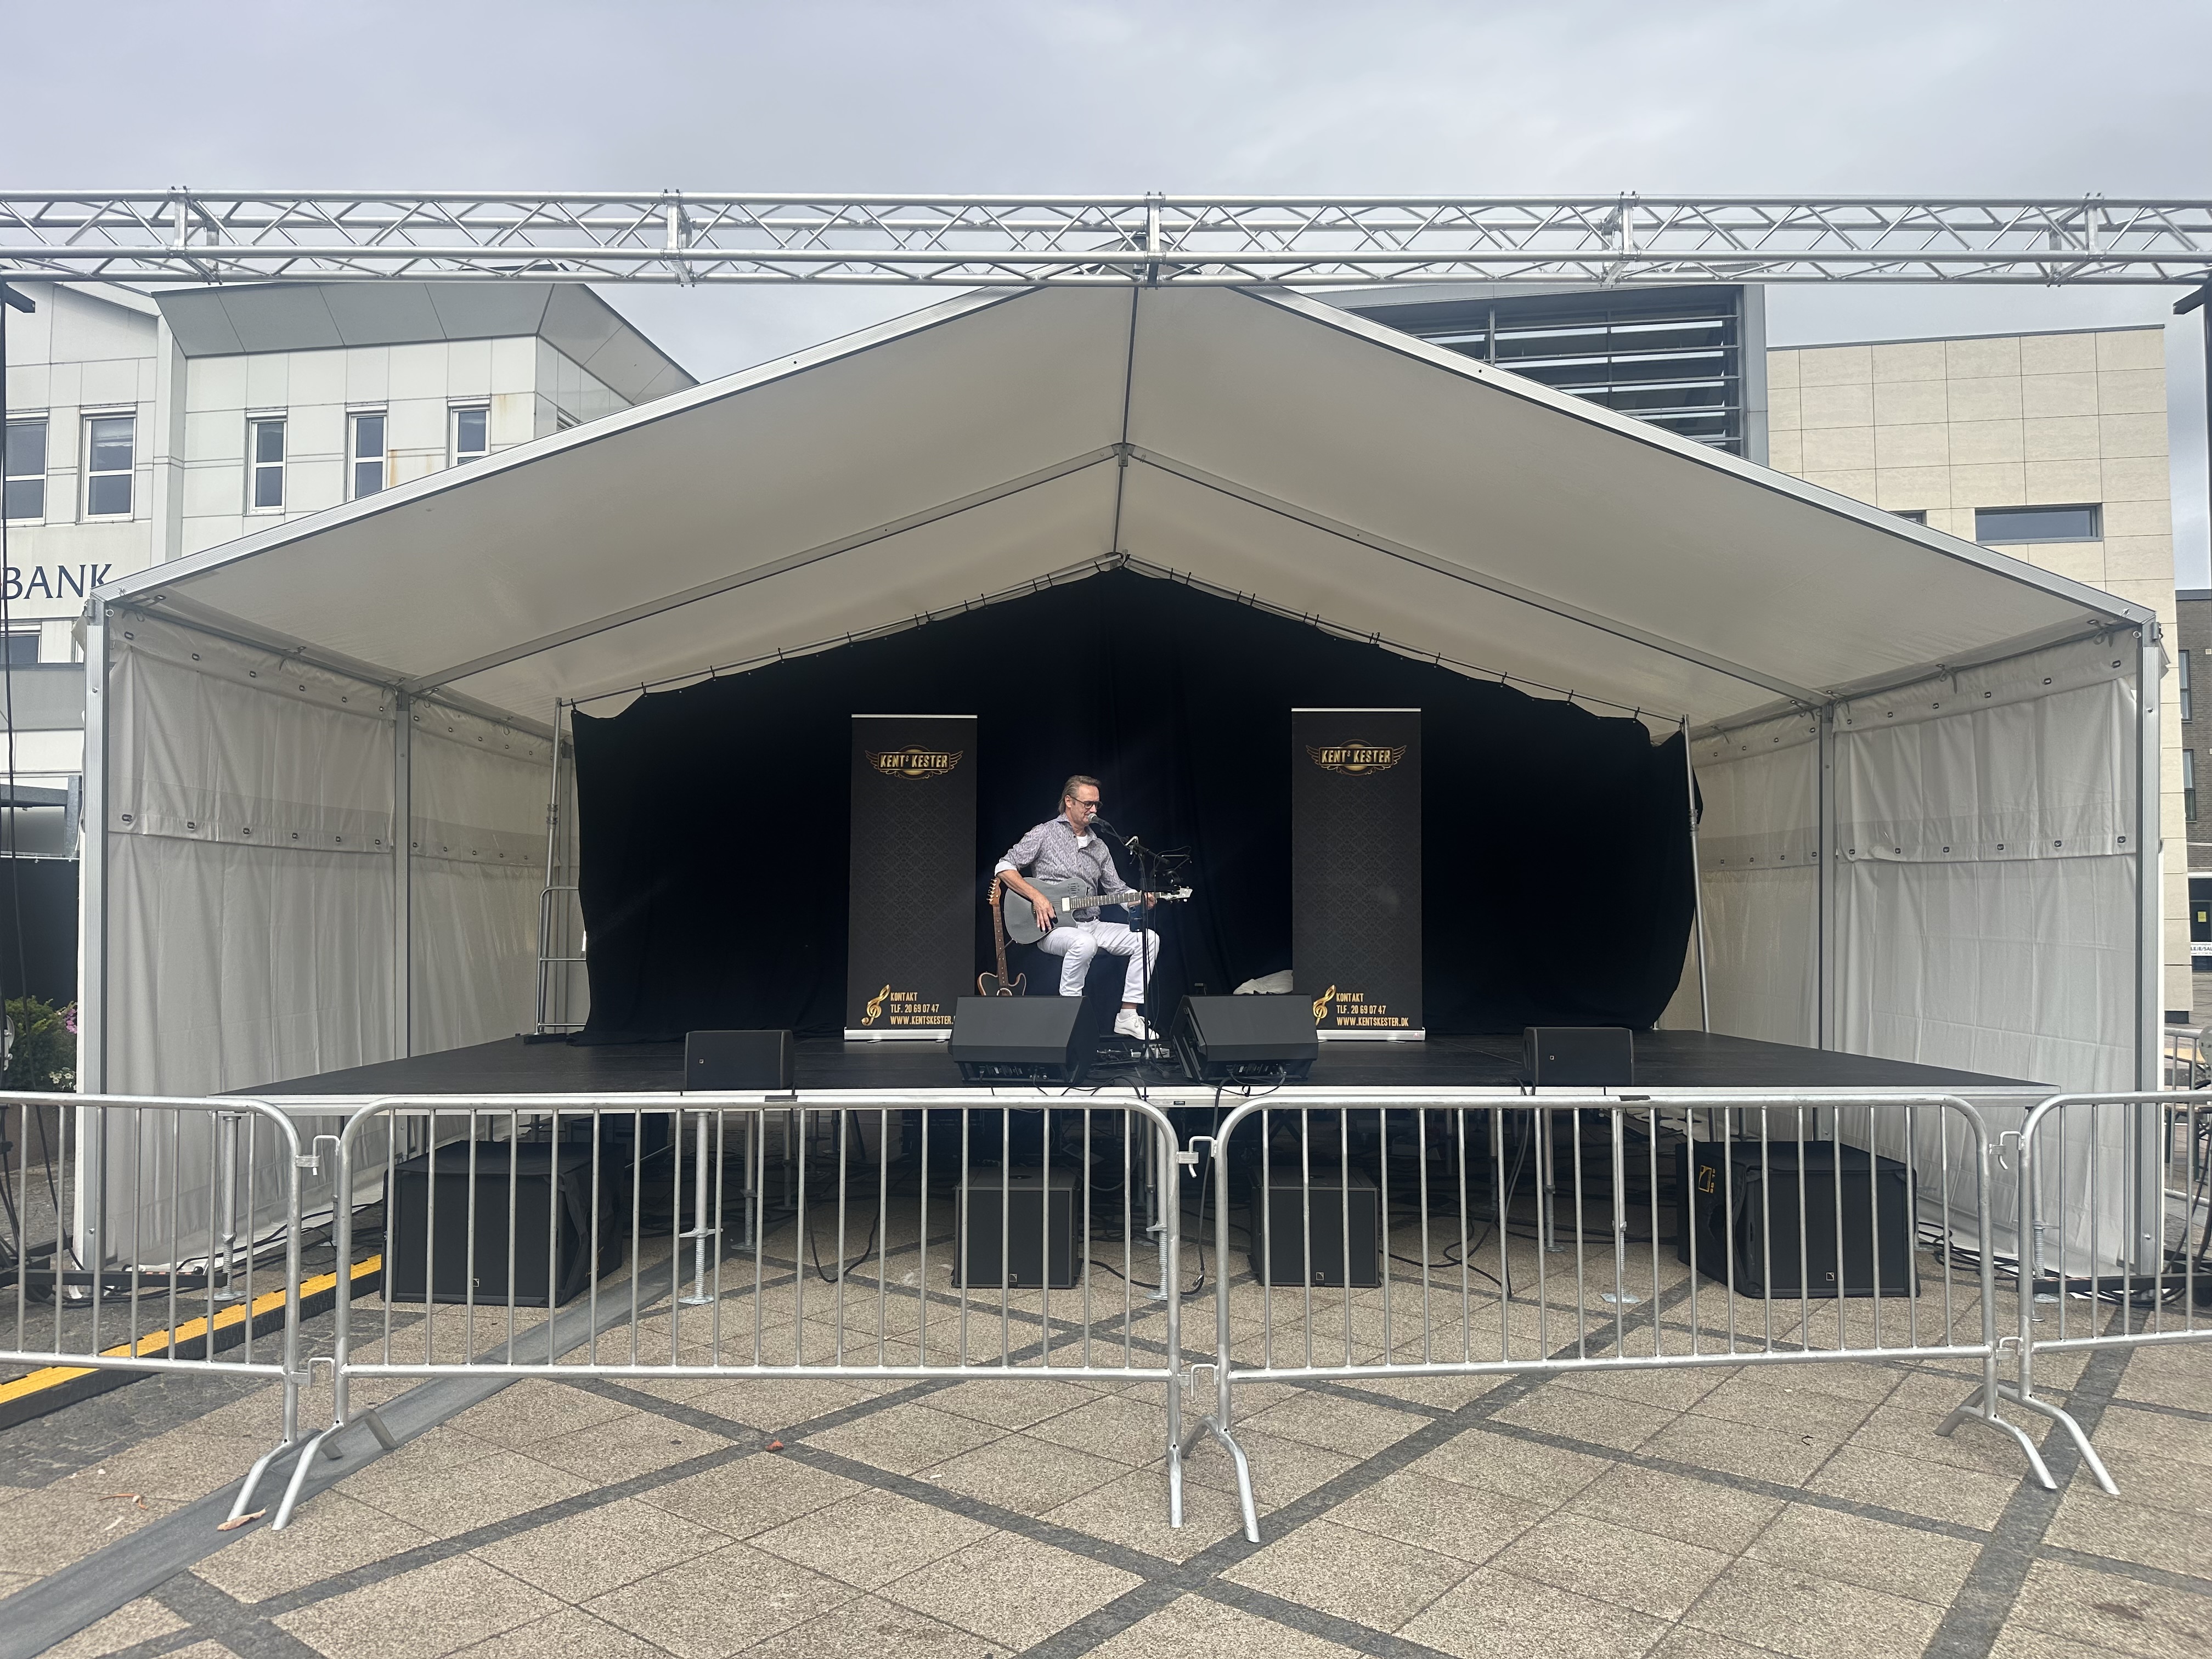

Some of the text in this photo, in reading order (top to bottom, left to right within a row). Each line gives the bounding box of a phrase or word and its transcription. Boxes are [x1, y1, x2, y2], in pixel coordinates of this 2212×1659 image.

[1, 563, 112, 600] BANK
[1353, 750, 1391, 763] KESTER
[911, 755, 948, 768] KESTER
[890, 992, 918, 1001] KONTAKT
[1336, 993, 1364, 1002] KONTAKT
[890, 1004, 940, 1013] TLF. 20 69 07 47
[1336, 1005, 1386, 1014] TLF. 20 69 07 47
[1336, 1017, 1409, 1026] WWW.KENTSKESTER.DK
